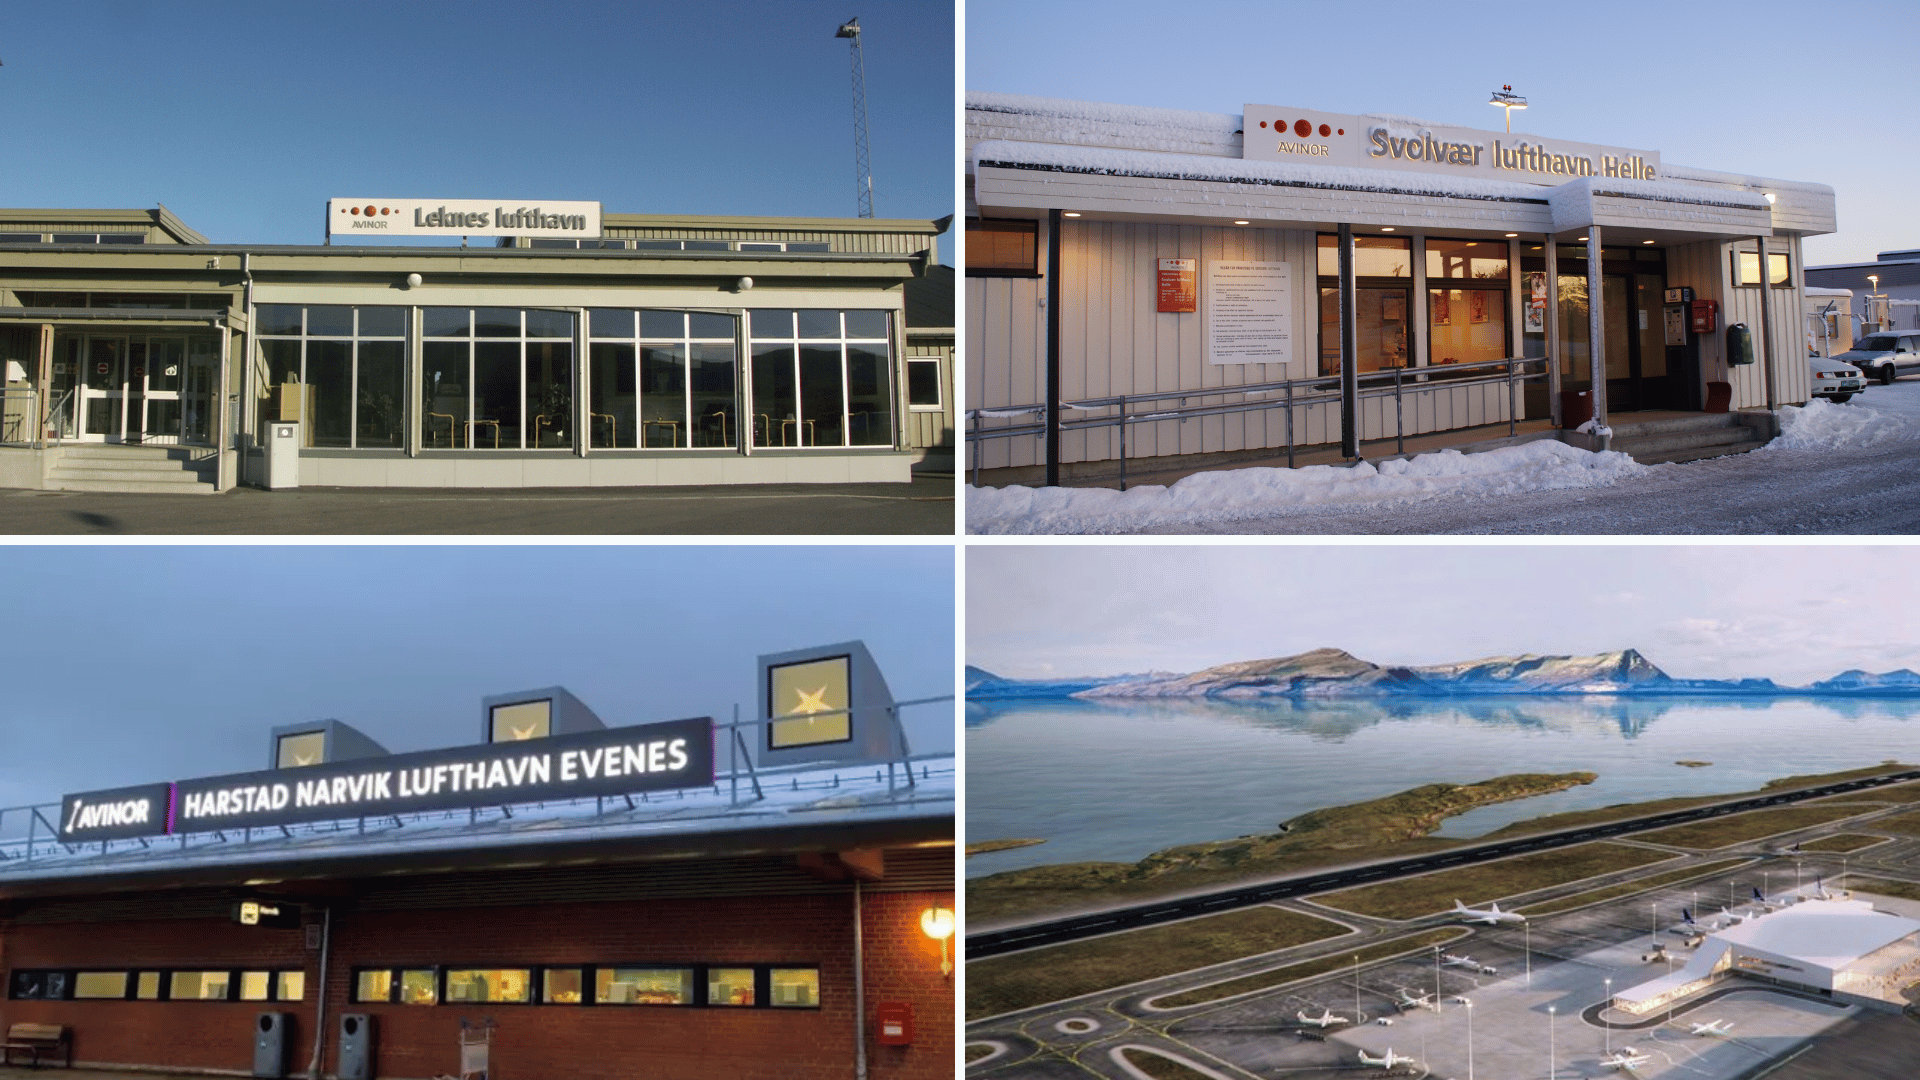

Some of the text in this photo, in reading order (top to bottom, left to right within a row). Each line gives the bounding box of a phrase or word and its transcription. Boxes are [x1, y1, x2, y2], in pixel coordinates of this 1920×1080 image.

[1277, 140, 1329, 157] AVINOR
[1371, 128, 1484, 166] Svolvær
[1602, 155, 1656, 181] Helle
[352, 220, 388, 229] AVINOR
[414, 206, 586, 231] Leknes lufthavn
[184, 739, 688, 819] HARSTAD NARVIK LUFTHAVN EVENES
[77, 799, 149, 829] AVINOR
